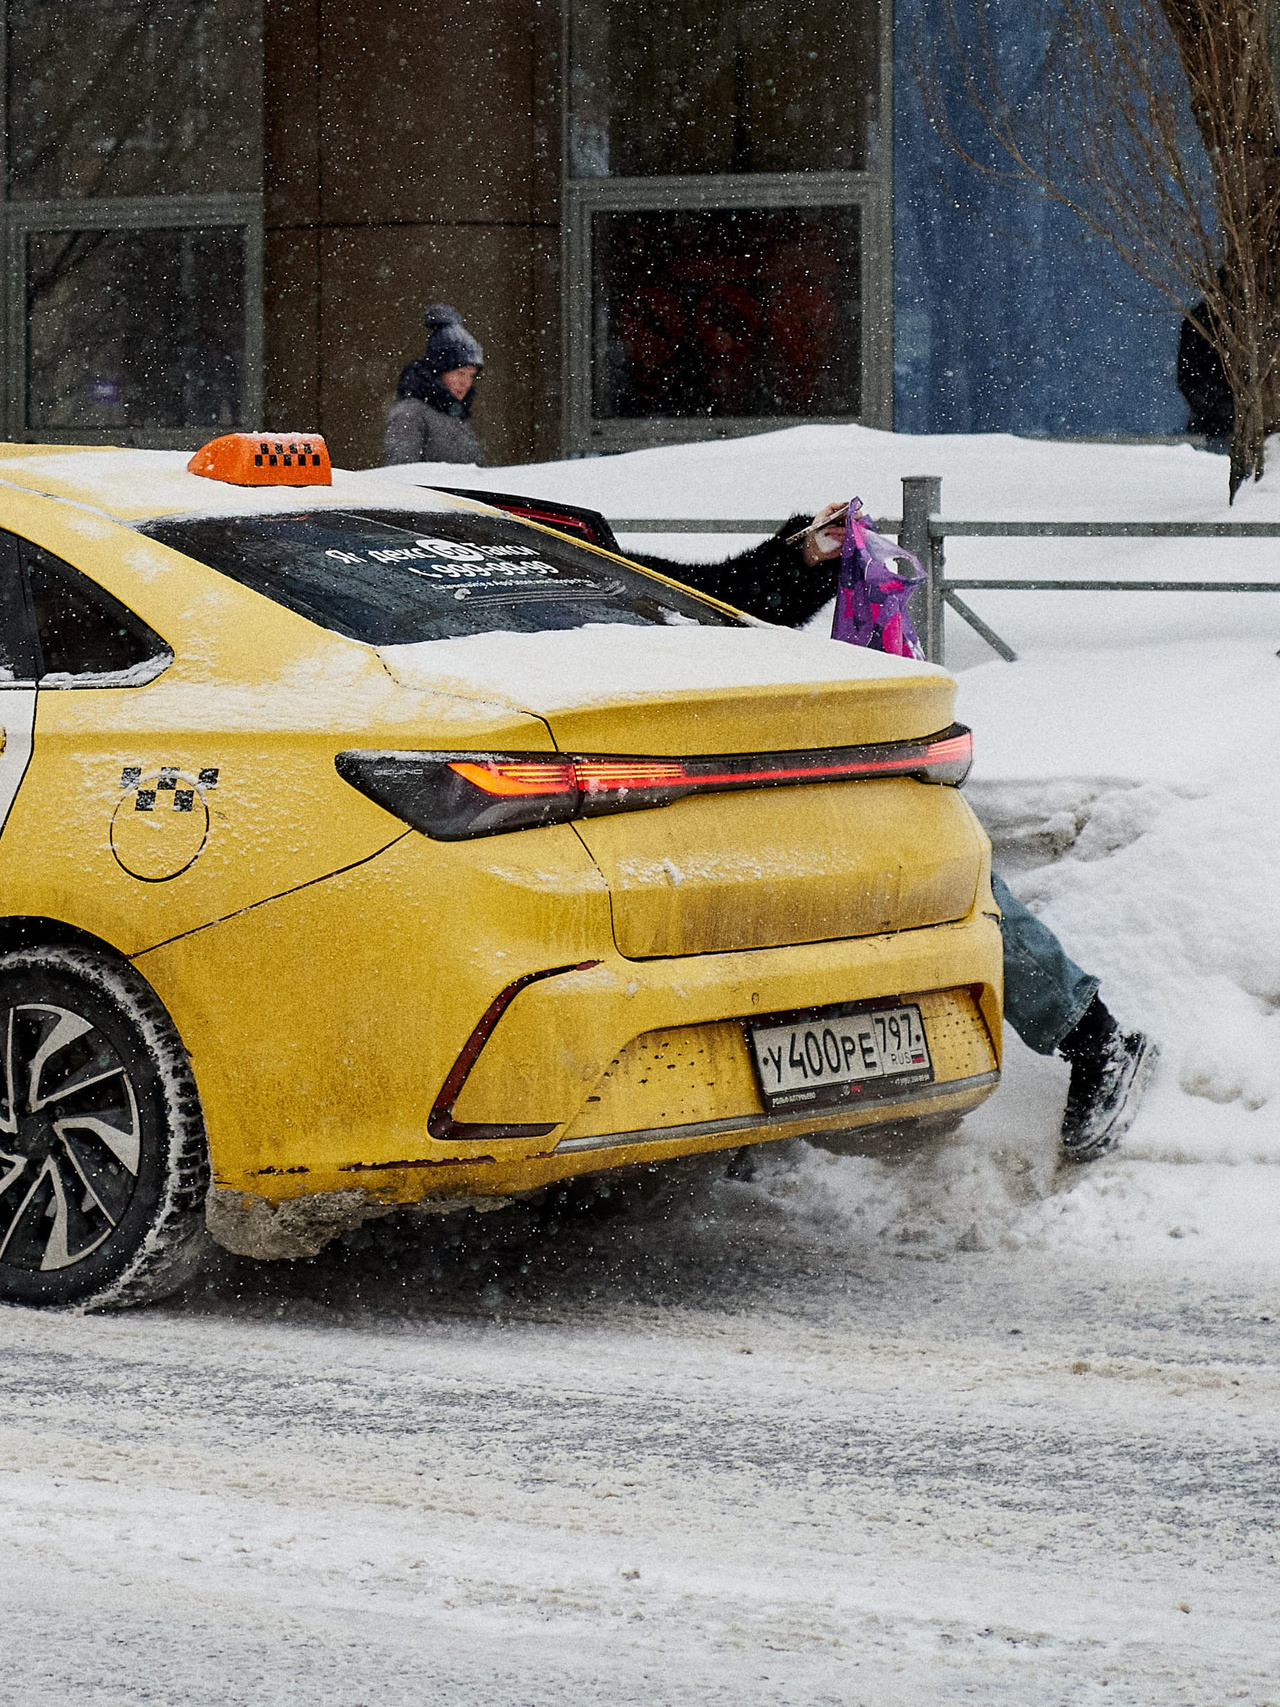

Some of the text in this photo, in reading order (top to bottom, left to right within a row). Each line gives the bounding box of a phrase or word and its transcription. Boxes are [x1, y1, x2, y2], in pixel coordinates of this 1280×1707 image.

[460, 542, 540, 556] Такси
[431, 561, 559, 578] 999-99-99
[874, 1012, 913, 1053] 797
[891, 1052, 912, 1066] RUS
